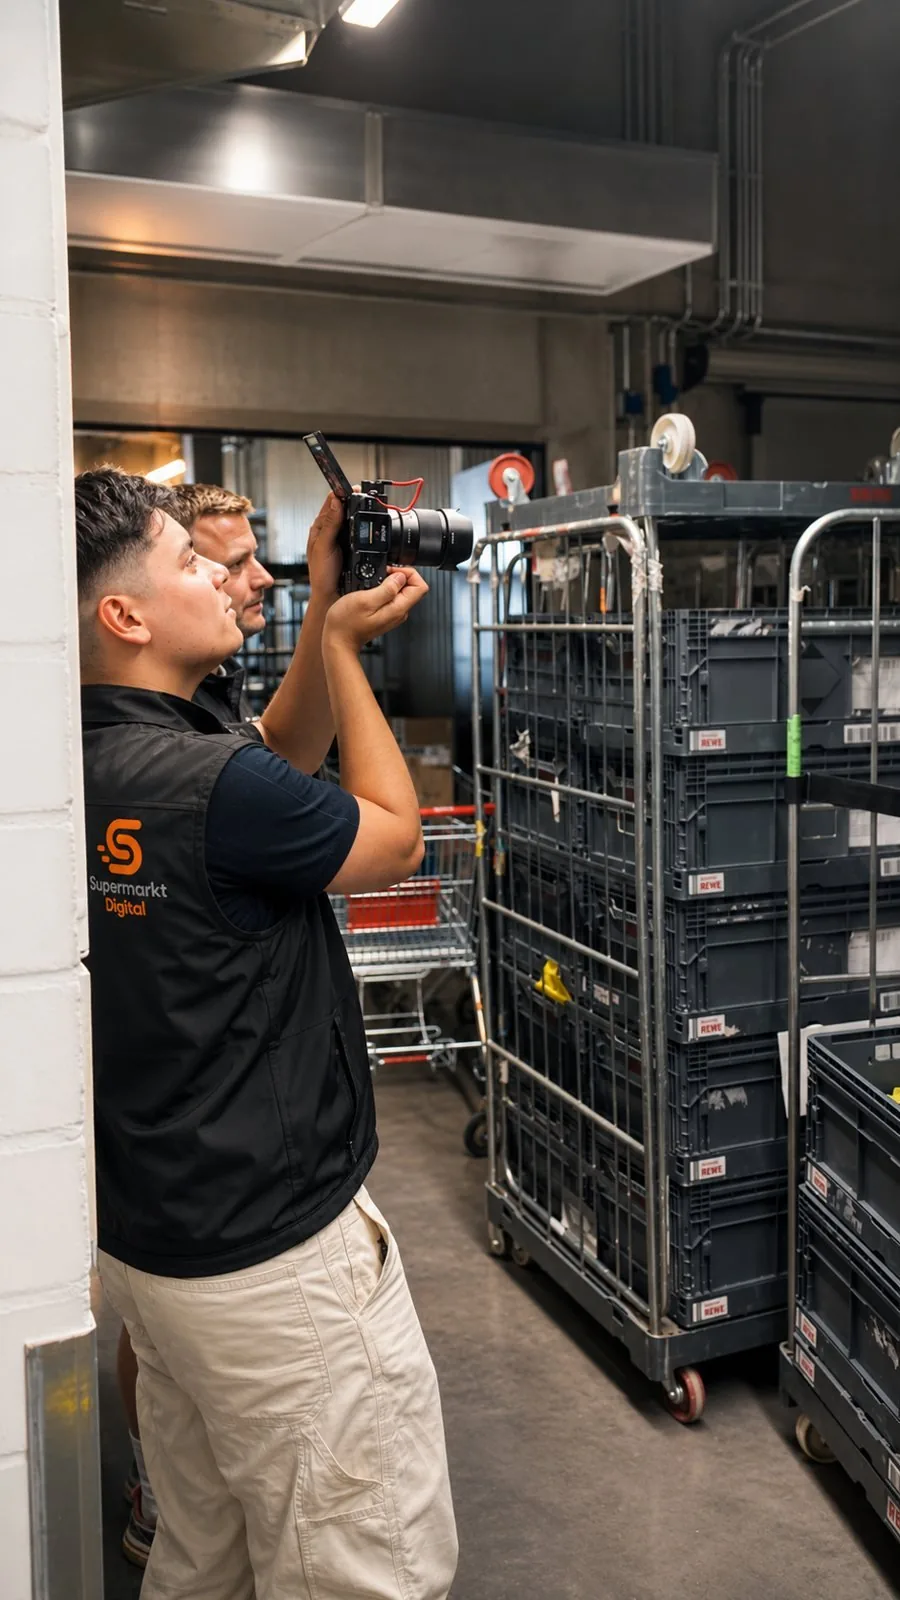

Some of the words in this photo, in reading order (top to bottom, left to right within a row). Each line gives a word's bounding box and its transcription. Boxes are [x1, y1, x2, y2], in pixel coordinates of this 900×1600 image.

[701, 737, 723, 748] REWE
[89, 876, 168, 898] Supermarkt
[700, 880, 722, 890] REWE
[105, 897, 147, 918] Digital
[701, 1023, 722, 1034] REWE
[701, 1166, 723, 1177] REWE
[704, 1305, 725, 1317] REWE
